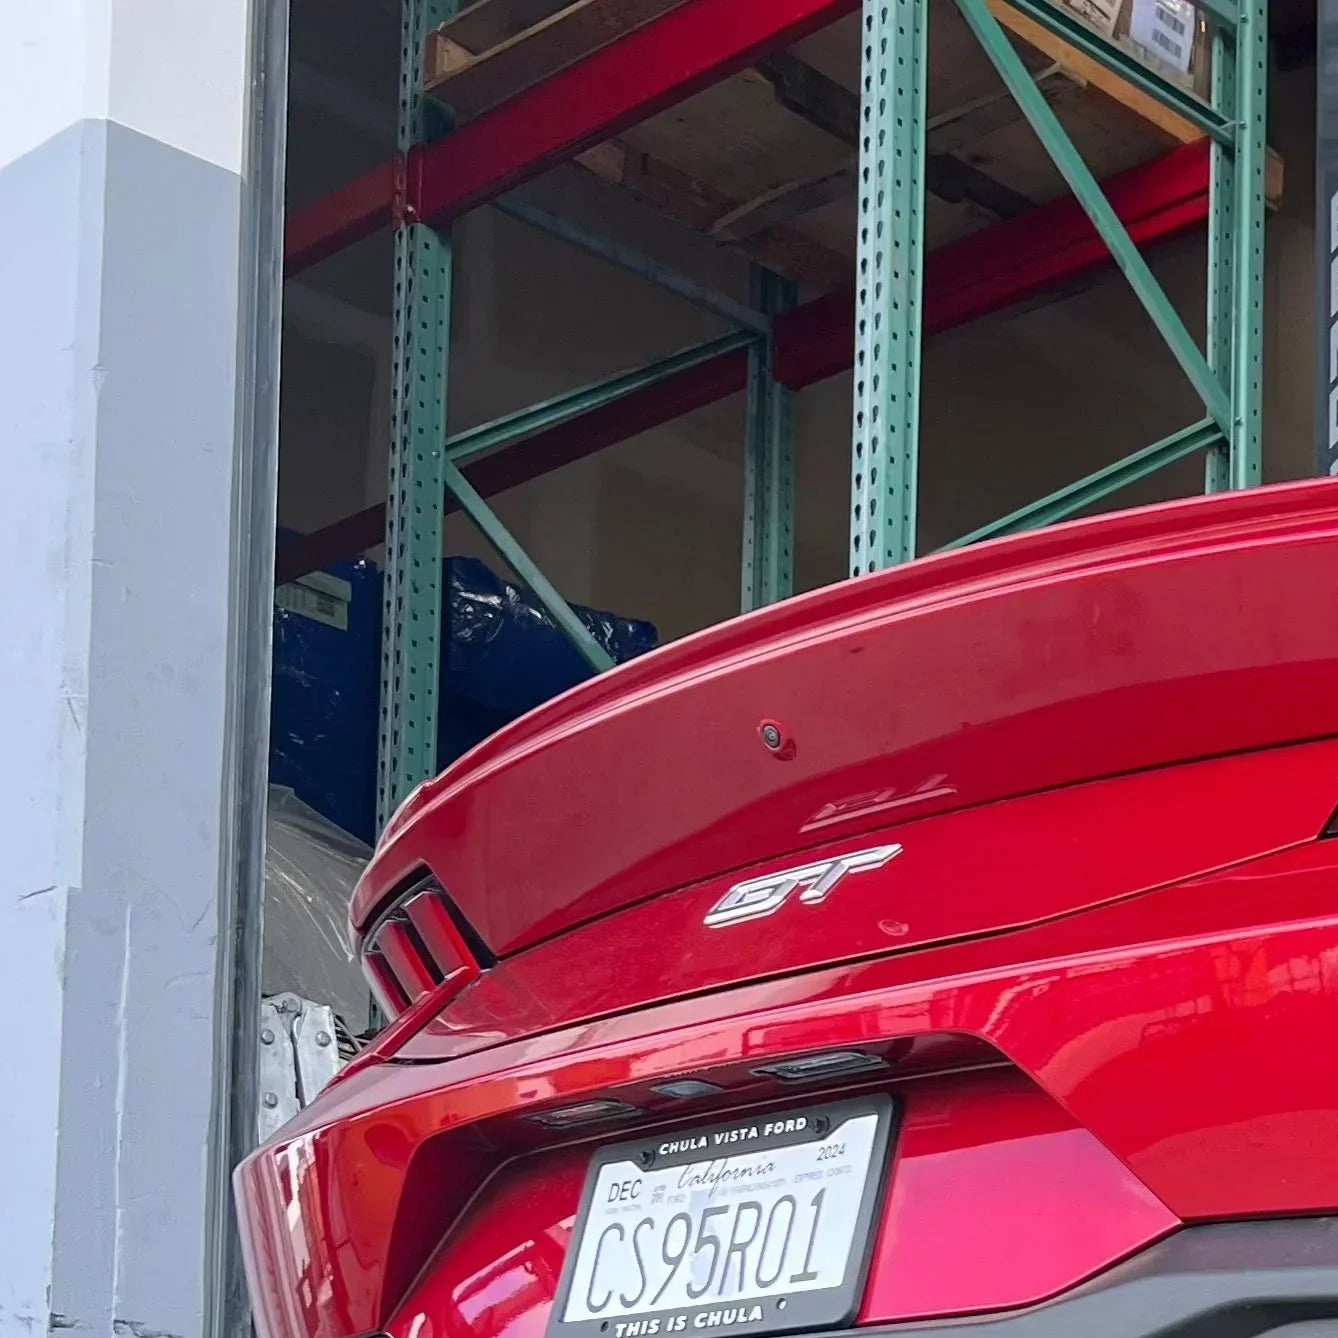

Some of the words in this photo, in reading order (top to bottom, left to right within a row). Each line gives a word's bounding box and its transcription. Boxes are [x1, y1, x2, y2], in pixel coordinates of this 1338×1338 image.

[703, 843, 904, 928] GT
[659, 1139, 708, 1155] CHULA
[714, 1127, 759, 1145] VISTA
[764, 1117, 807, 1137] FORD
[607, 1178, 643, 1203] DEC
[615, 1319, 660, 1338] THIS
[667, 1316, 687, 1332] IS
[694, 1306, 764, 1329] CHULA
